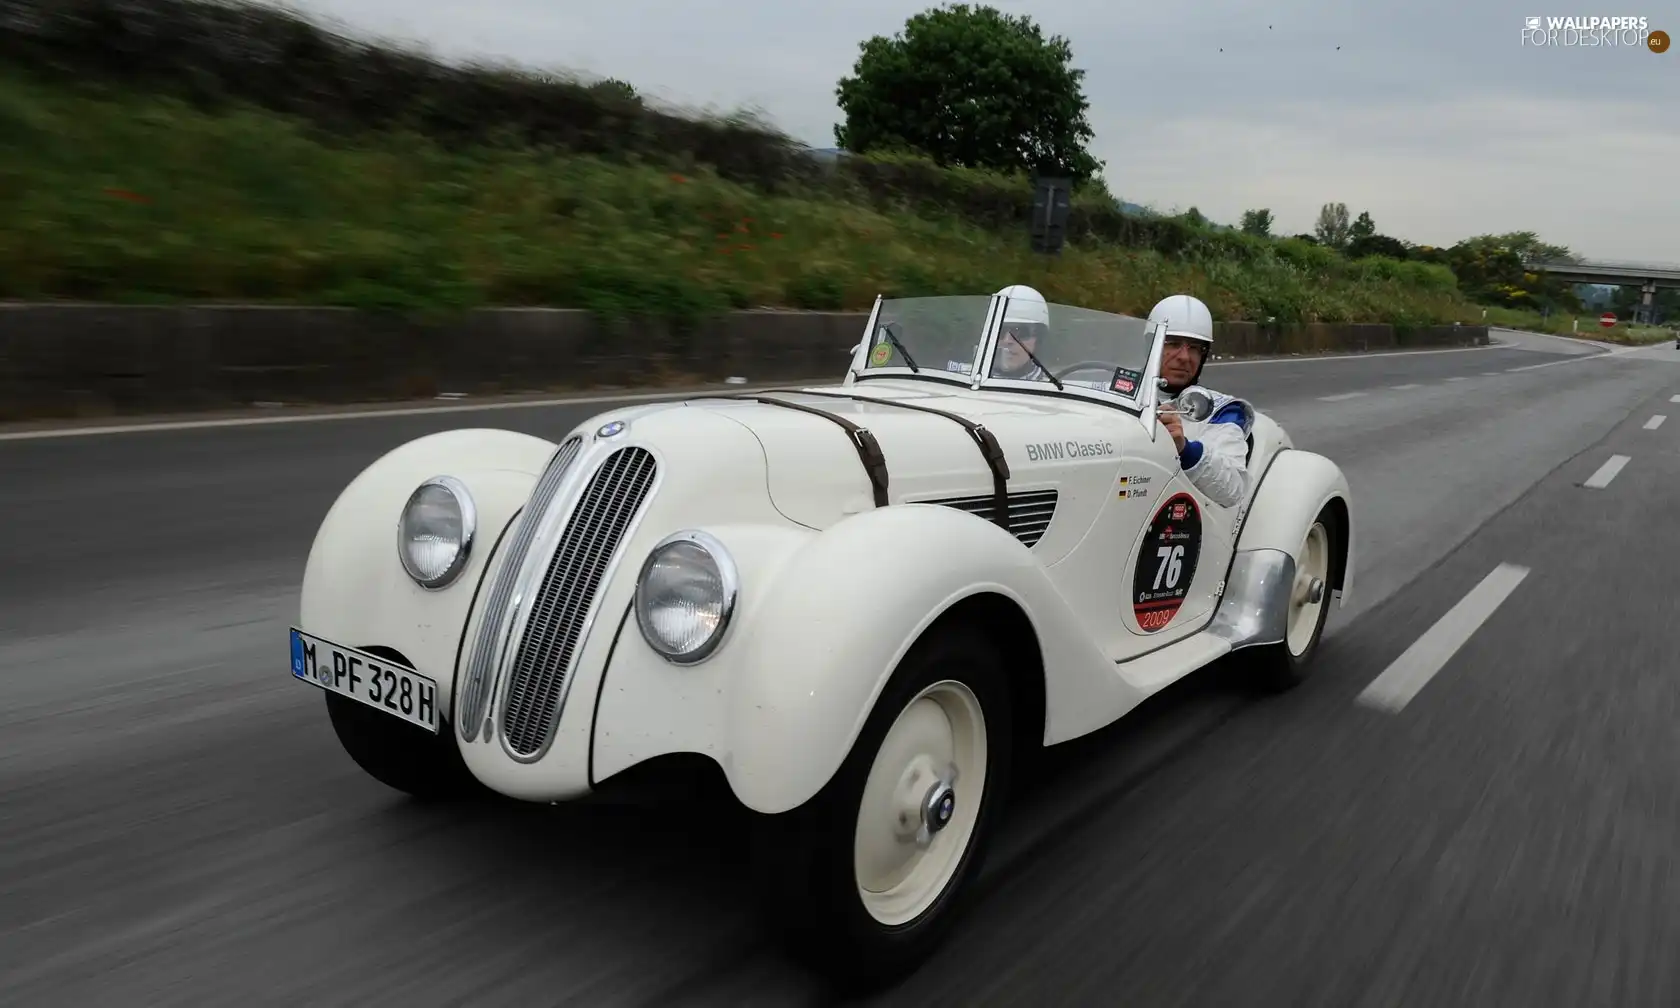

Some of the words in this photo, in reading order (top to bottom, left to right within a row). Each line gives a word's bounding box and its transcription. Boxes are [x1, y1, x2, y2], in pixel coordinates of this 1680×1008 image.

[1025, 442, 1064, 461] BMW
[1065, 440, 1114, 458] Classic
[1152, 545, 1185, 590] 76
[1142, 609, 1170, 628] 2009
[302, 639, 318, 680] M
